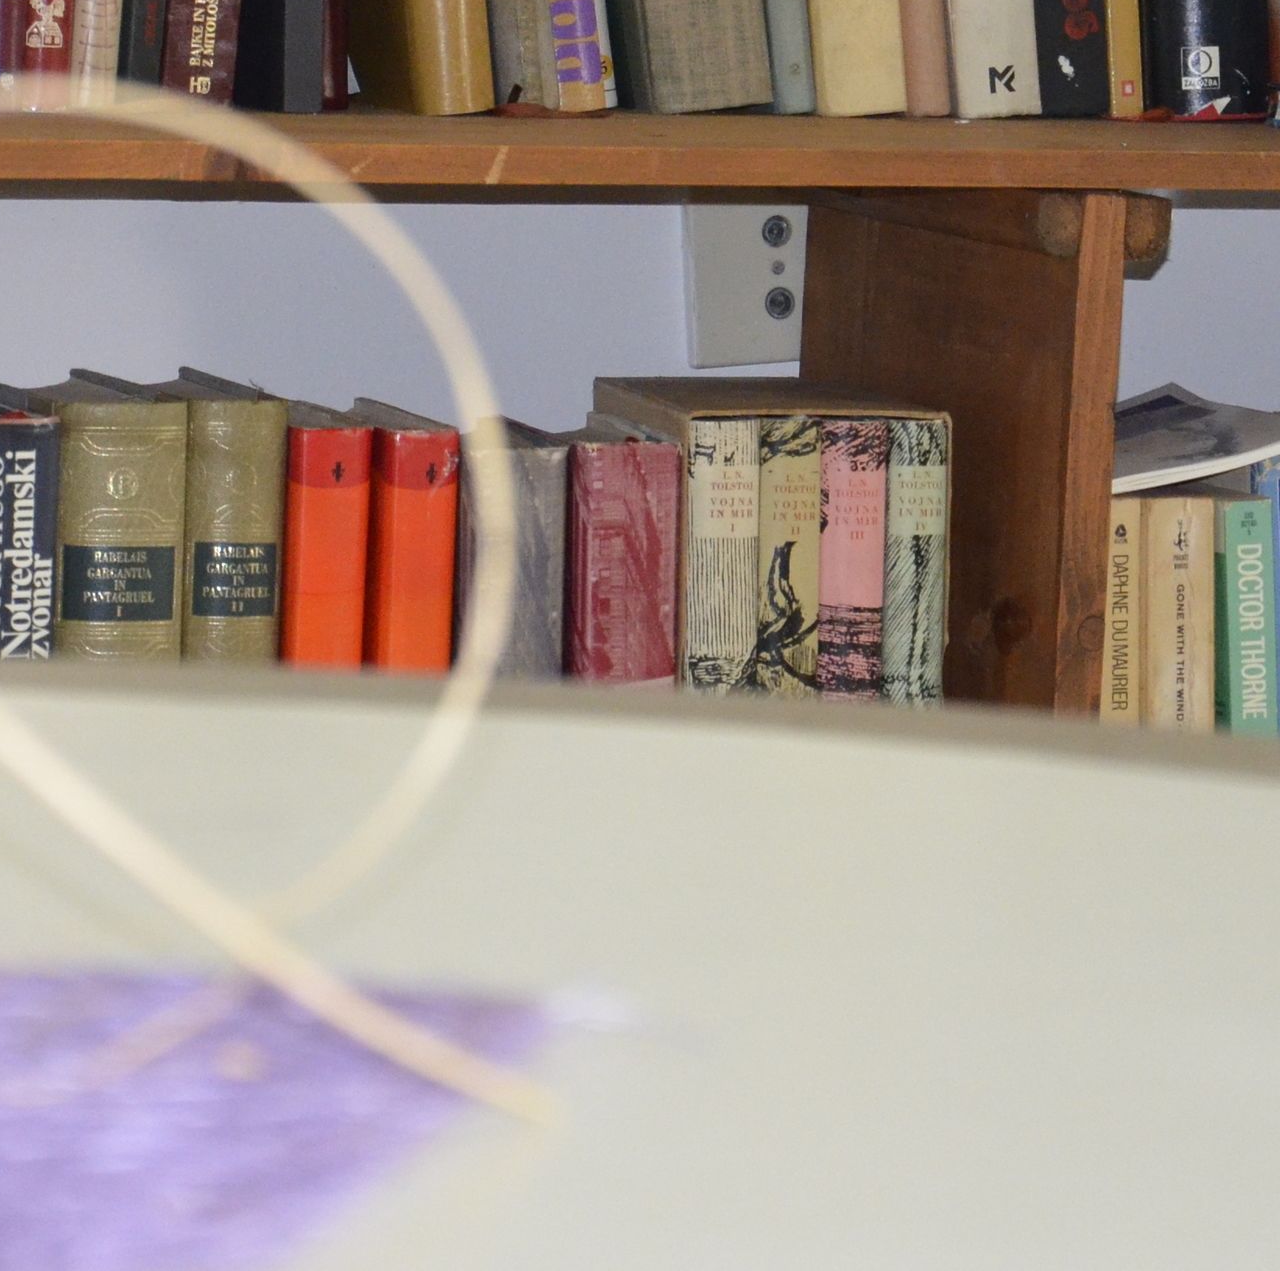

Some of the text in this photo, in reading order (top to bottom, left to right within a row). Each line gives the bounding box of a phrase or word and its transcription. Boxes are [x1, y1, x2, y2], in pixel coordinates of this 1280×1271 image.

[193, 7, 204, 22] IN
[189, 25, 205, 66] BAJKE
[1, 450, 37, 659] Notredamski
[94, 551, 147, 564] RABELAIS
[213, 546, 265, 559] RABELAIS
[87, 567, 151, 581] GARGANTUA
[206, 561, 268, 576] GARGANTUA
[114, 581, 126, 590] IN
[233, 576, 245, 586] IN
[1237, 543, 1264, 631] DOCTOR
[82, 591, 155, 605] PANTAGRUEL
[202, 585, 270, 599] PANTAGRUEL
[30, 553, 53, 658] zvonar
[1111, 554, 1129, 710] DAPHNE DU MAURIER
[1176, 584, 1185, 722] GONE WITH THE WIND
[1240, 636, 1267, 719] THORNE
